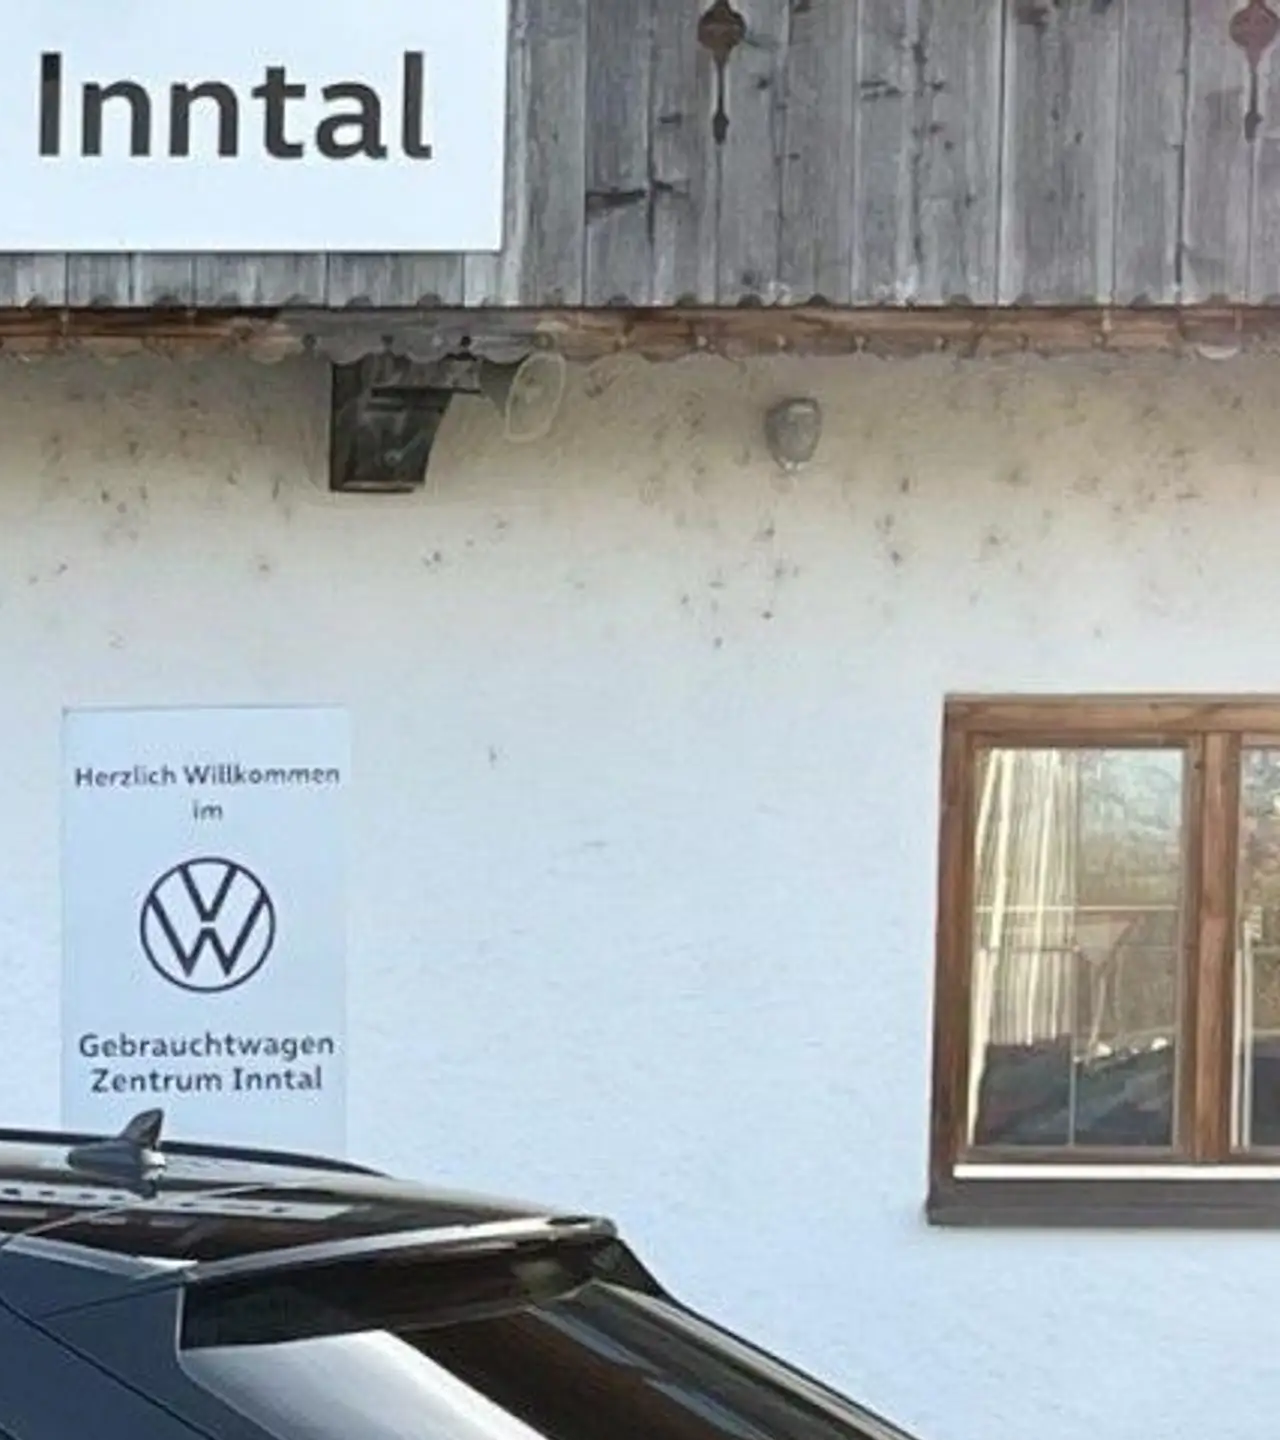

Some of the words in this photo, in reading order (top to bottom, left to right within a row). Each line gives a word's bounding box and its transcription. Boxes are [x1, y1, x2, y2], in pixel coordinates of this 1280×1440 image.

[39, 50, 433, 160] Inntal
[74, 765, 177, 788] Herzlich
[183, 764, 341, 787] Willkommen
[192, 800, 223, 820] im
[143, 861, 272, 987] VW
[78, 1031, 335, 1063] Gebrauchtwagen
[90, 1068, 223, 1094] Zentrum
[233, 1065, 323, 1092] Inntal
